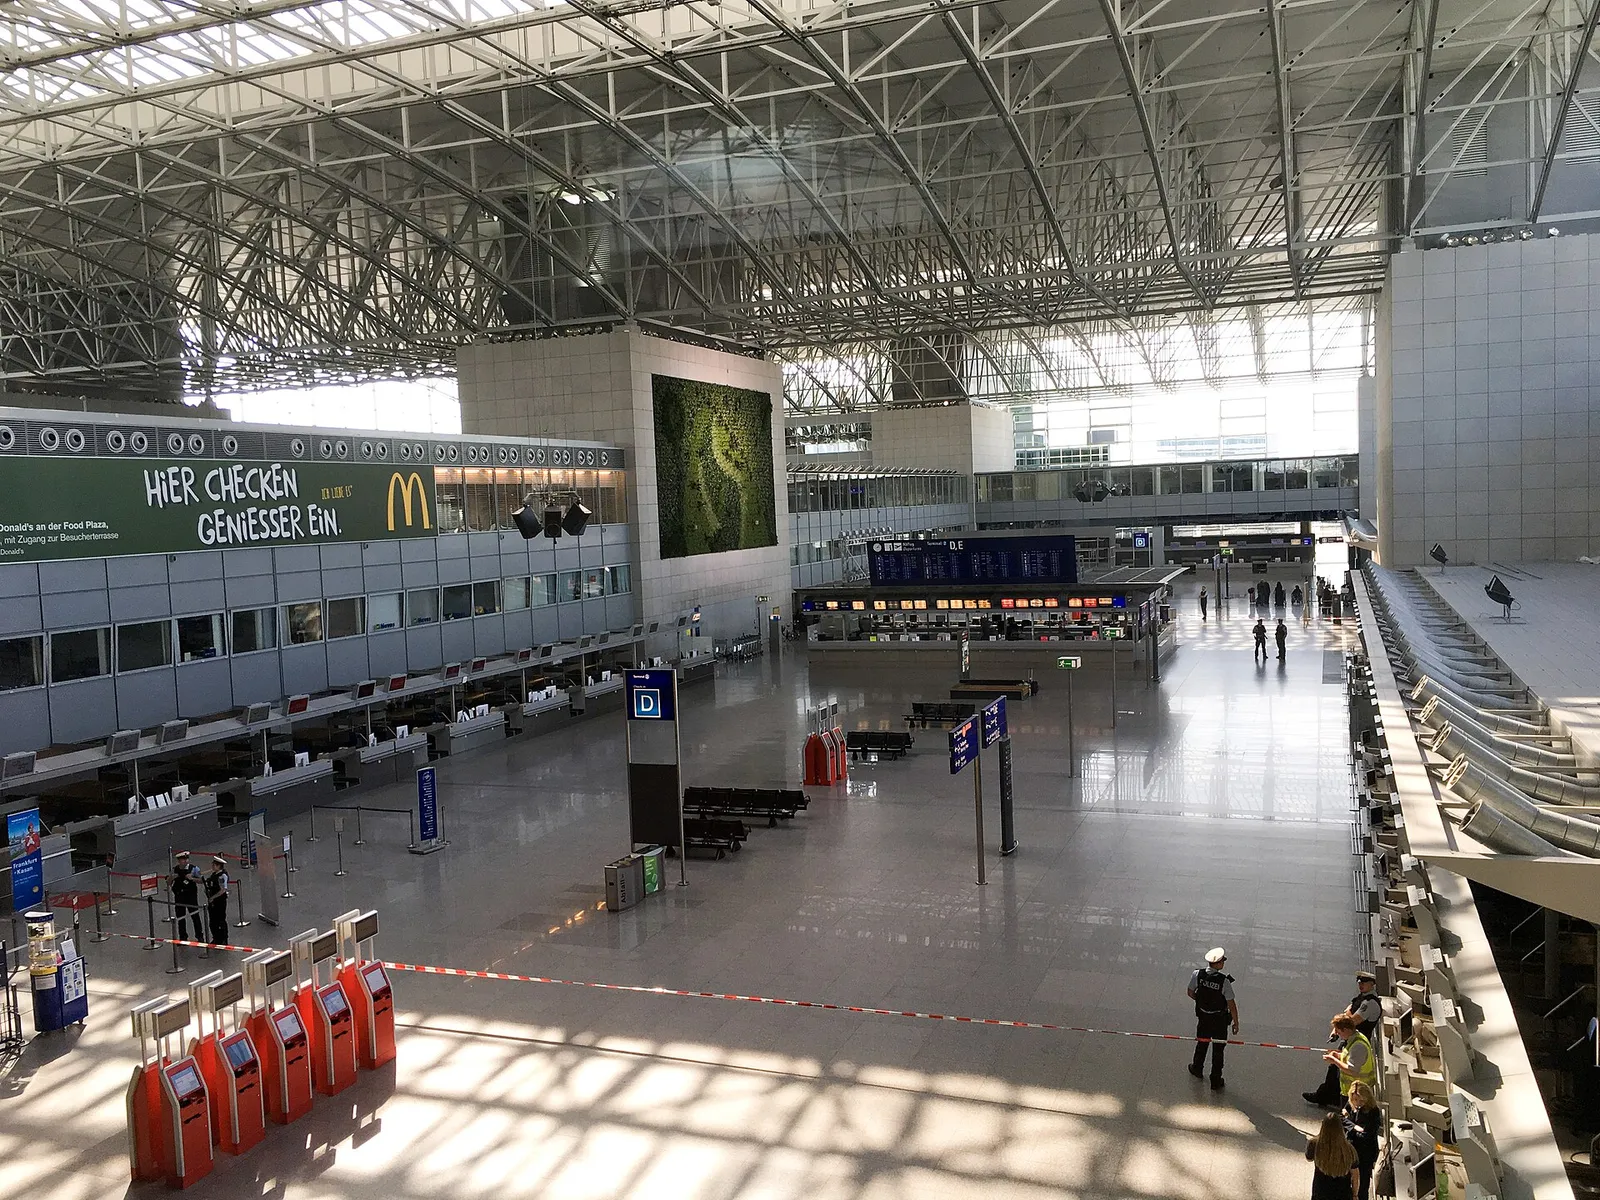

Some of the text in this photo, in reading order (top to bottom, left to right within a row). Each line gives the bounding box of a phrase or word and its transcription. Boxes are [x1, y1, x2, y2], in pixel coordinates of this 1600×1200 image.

[204, 463, 299, 504] CHECKEN
[36, 523, 46, 531] an
[48, 522, 61, 531] der
[63, 521, 84, 530] Food
[85, 520, 109, 530] Plaza,
[4, 536, 16, 544] mit
[18, 535, 46, 546] Zugang
[47, 535, 59, 543] zur
[60, 532, 119, 542] Besucherterrasse
[641, 695, 654, 712] D
[13, 858, 38, 869] Frankfurt
[1199, 979, 1221, 991] POLIZEI
